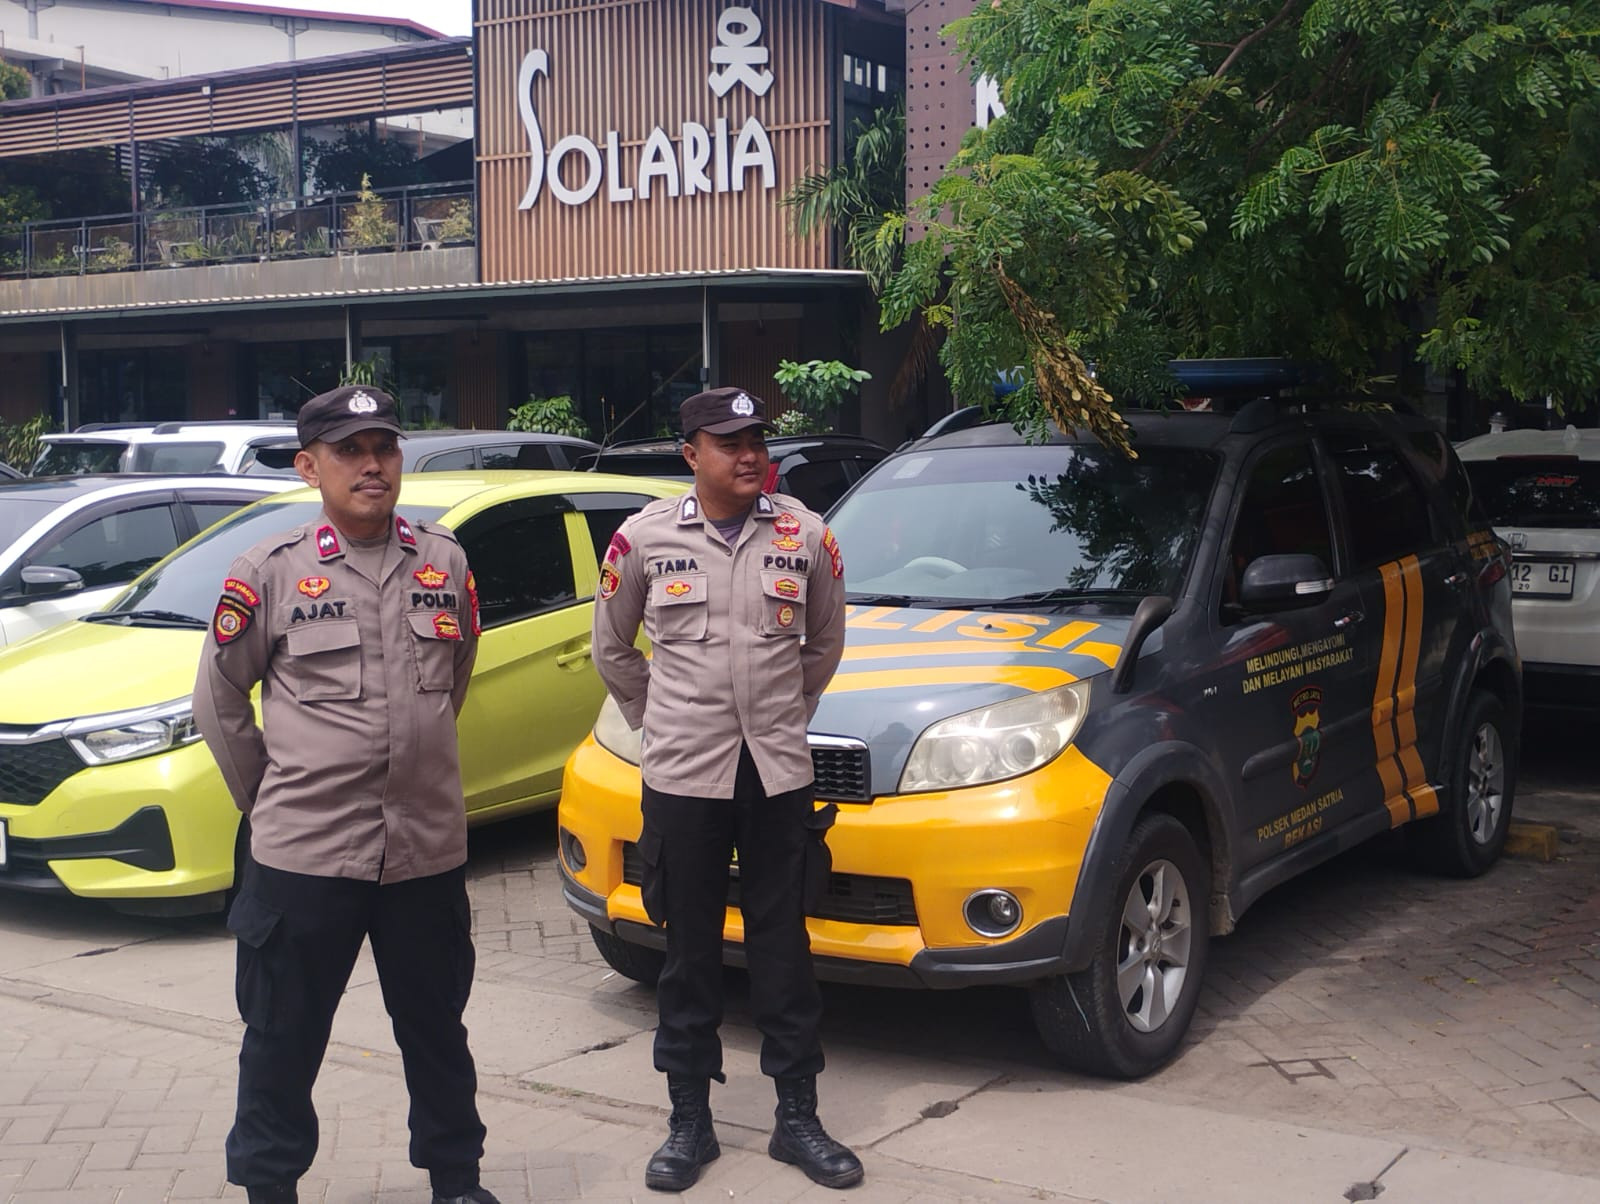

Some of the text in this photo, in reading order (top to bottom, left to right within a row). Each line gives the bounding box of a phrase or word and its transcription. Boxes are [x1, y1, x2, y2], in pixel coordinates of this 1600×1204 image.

[655, 558, 699, 575] TAMA
[763, 554, 809, 573] POLRI
[1549, 565, 1569, 583] GI
[411, 592, 456, 609] POLRI
[291, 601, 346, 623] AJAT
[846, 605, 1101, 649] LISI
[1242, 676, 1261, 695] DAN
[1262, 664, 1304, 687] MELAYANI
[1305, 647, 1354, 674] MASYARAKAT
[1257, 787, 1344, 843] POLSEK MEDAN SATRIA
